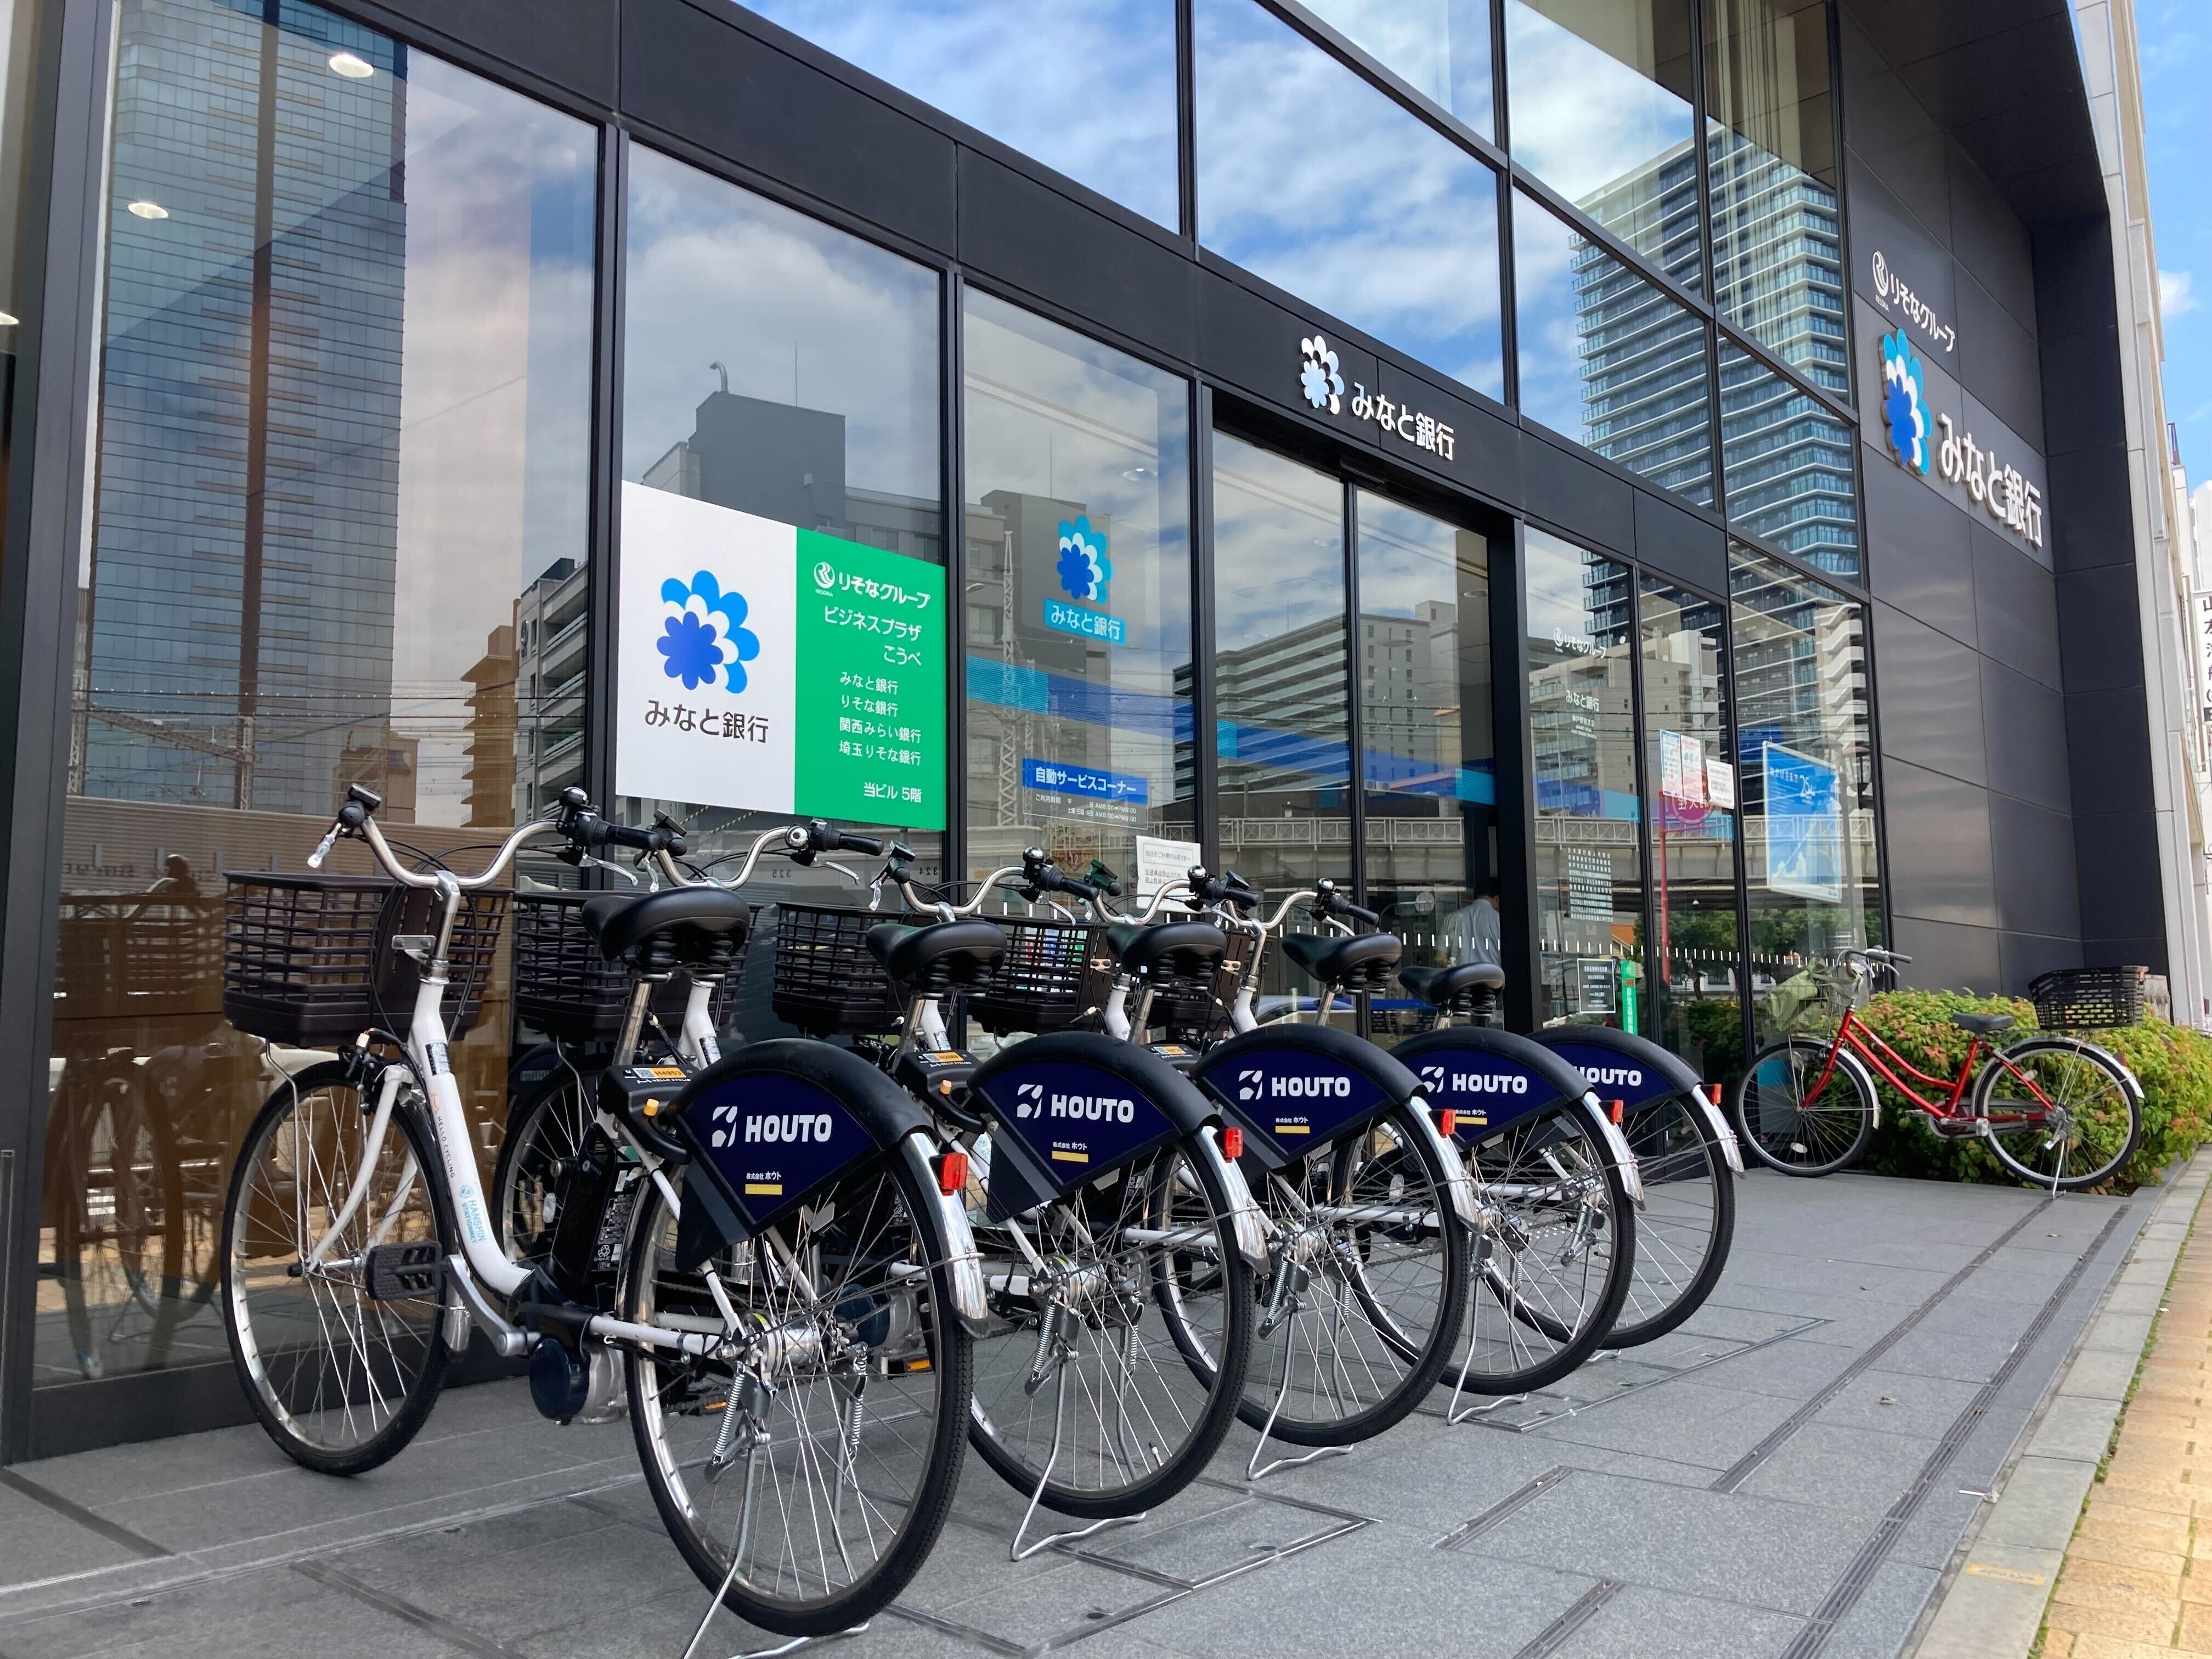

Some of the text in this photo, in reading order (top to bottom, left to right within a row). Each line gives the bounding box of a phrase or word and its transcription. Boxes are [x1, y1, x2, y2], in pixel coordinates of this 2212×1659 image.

[1875, 294, 1889, 312] RESONA
[1891, 273, 1955, 353] りそなグループ
[1351, 382, 1455, 461] みなと銀行
[1938, 413, 2043, 548] みなと銀行
[838, 571, 931, 609] りそなグループ
[825, 606, 922, 641] ビジネスプラザ
[1051, 605, 1121, 640] みなと銀行
[883, 645, 922, 667] こうべ
[1565, 634, 1607, 659] りそなグループ
[840, 672, 899, 695] みなと銀行
[841, 696, 899, 718] りそな銀行
[1566, 690, 1600, 713] みなと銀行
[644, 699, 769, 743] みなと銀行
[839, 717, 922, 744] 関西みらい銀行
[839, 740, 922, 766] 埼玉りそな銀行
[863, 781, 922, 804] 当ビル 5階
[1036, 766, 1136, 794] 自動サービスコーナー
[1036, 794, 1061, 805] ご利用時間
[1272, 1077, 1351, 1097] HOUTO
[1452, 1073, 1527, 1094] HOUTO
[1051, 1094, 1135, 1123] HOUTO
[745, 1114, 832, 1143] HOUTO
[437, 1116, 455, 1178] HELLO CYCLING
[1052, 1141, 1087, 1151] 株式会社 ホウト
[746, 1171, 782, 1181] 株式会社 ホウト
[468, 1199, 487, 1242] HANSHIN
